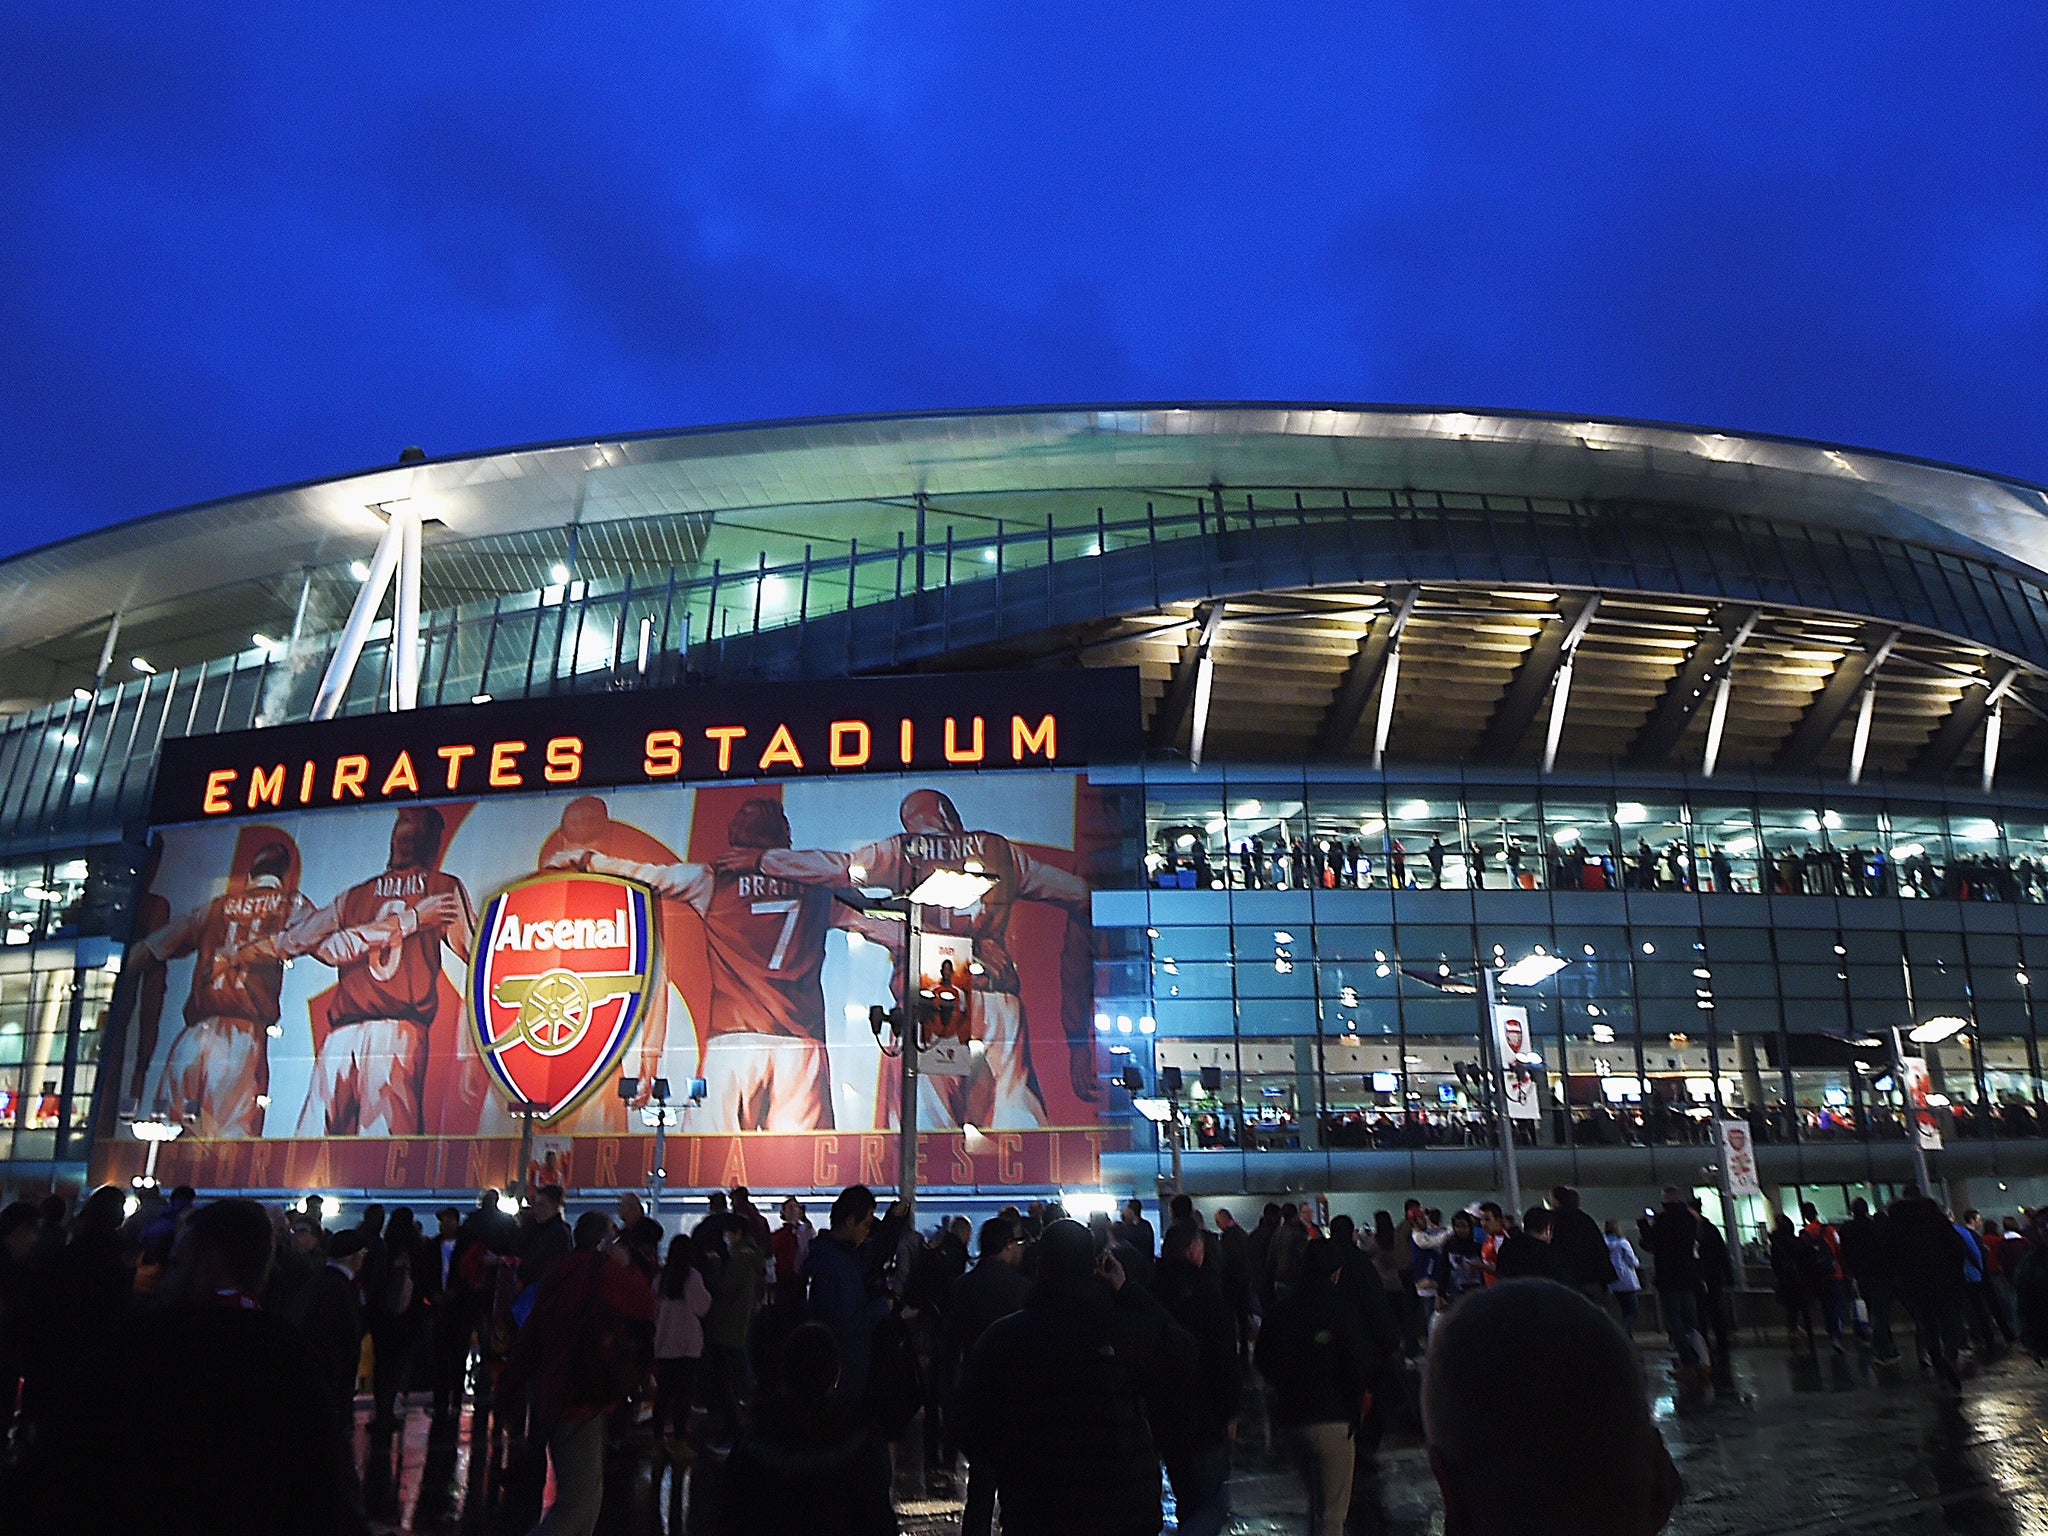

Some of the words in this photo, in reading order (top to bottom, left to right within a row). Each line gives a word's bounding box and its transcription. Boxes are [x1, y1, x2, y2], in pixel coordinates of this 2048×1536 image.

[203, 735, 584, 814] EMIRATES
[643, 714, 1057, 777] STADIUM
[921, 834, 986, 861] HENRY
[373, 872, 428, 897] ADAMS
[495, 909, 628, 951] Arsenal
[751, 900, 800, 970] 7
